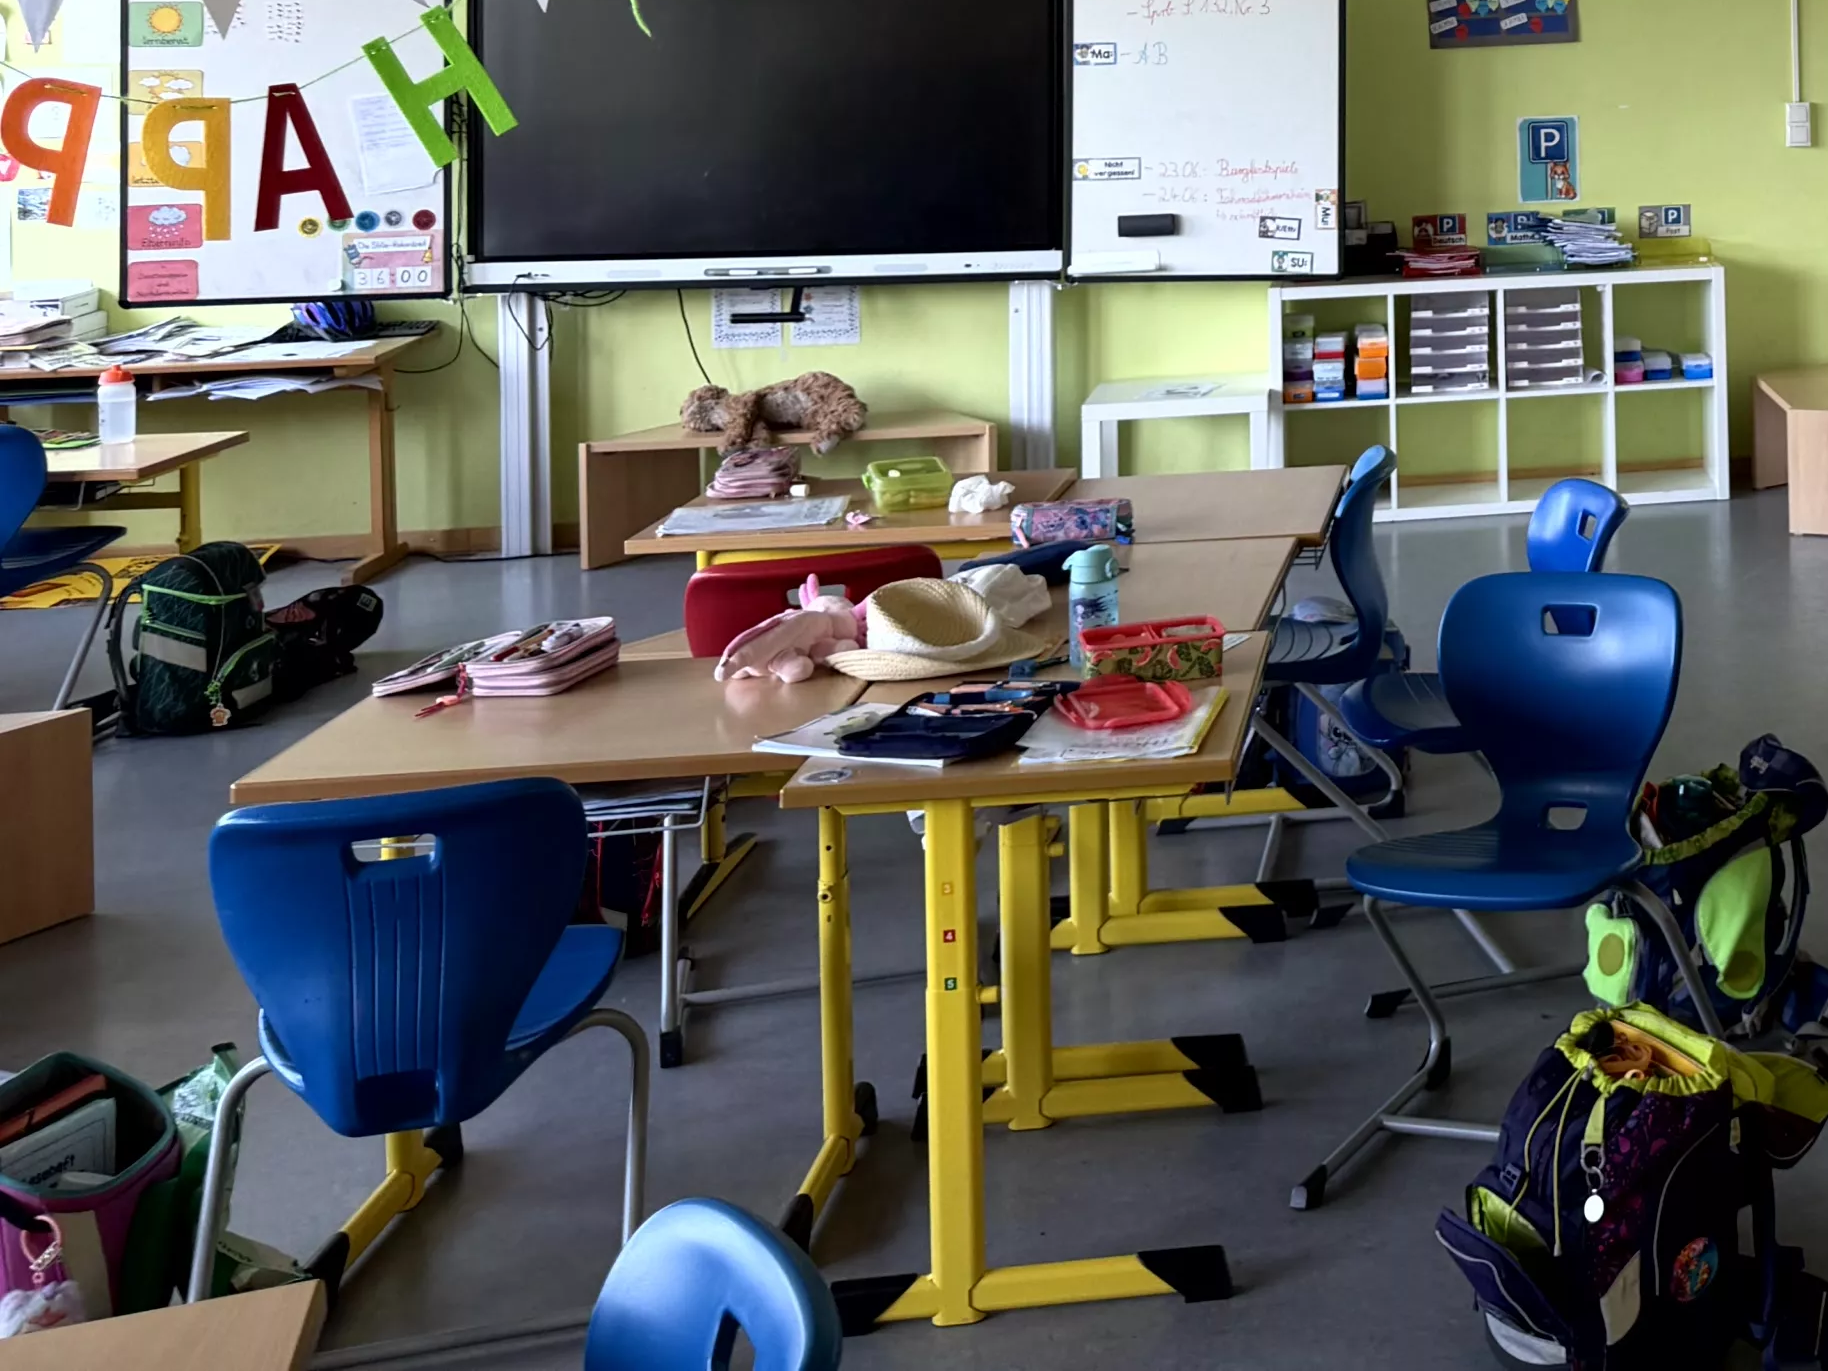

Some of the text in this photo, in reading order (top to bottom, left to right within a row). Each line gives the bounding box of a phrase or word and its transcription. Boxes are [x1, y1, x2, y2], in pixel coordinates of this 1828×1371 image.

[1540, 128, 1560, 157] P
[1667, 208, 1678, 222] P
[1443, 217, 1453, 231] P
[1433, 235, 1465, 246] Deutsch
